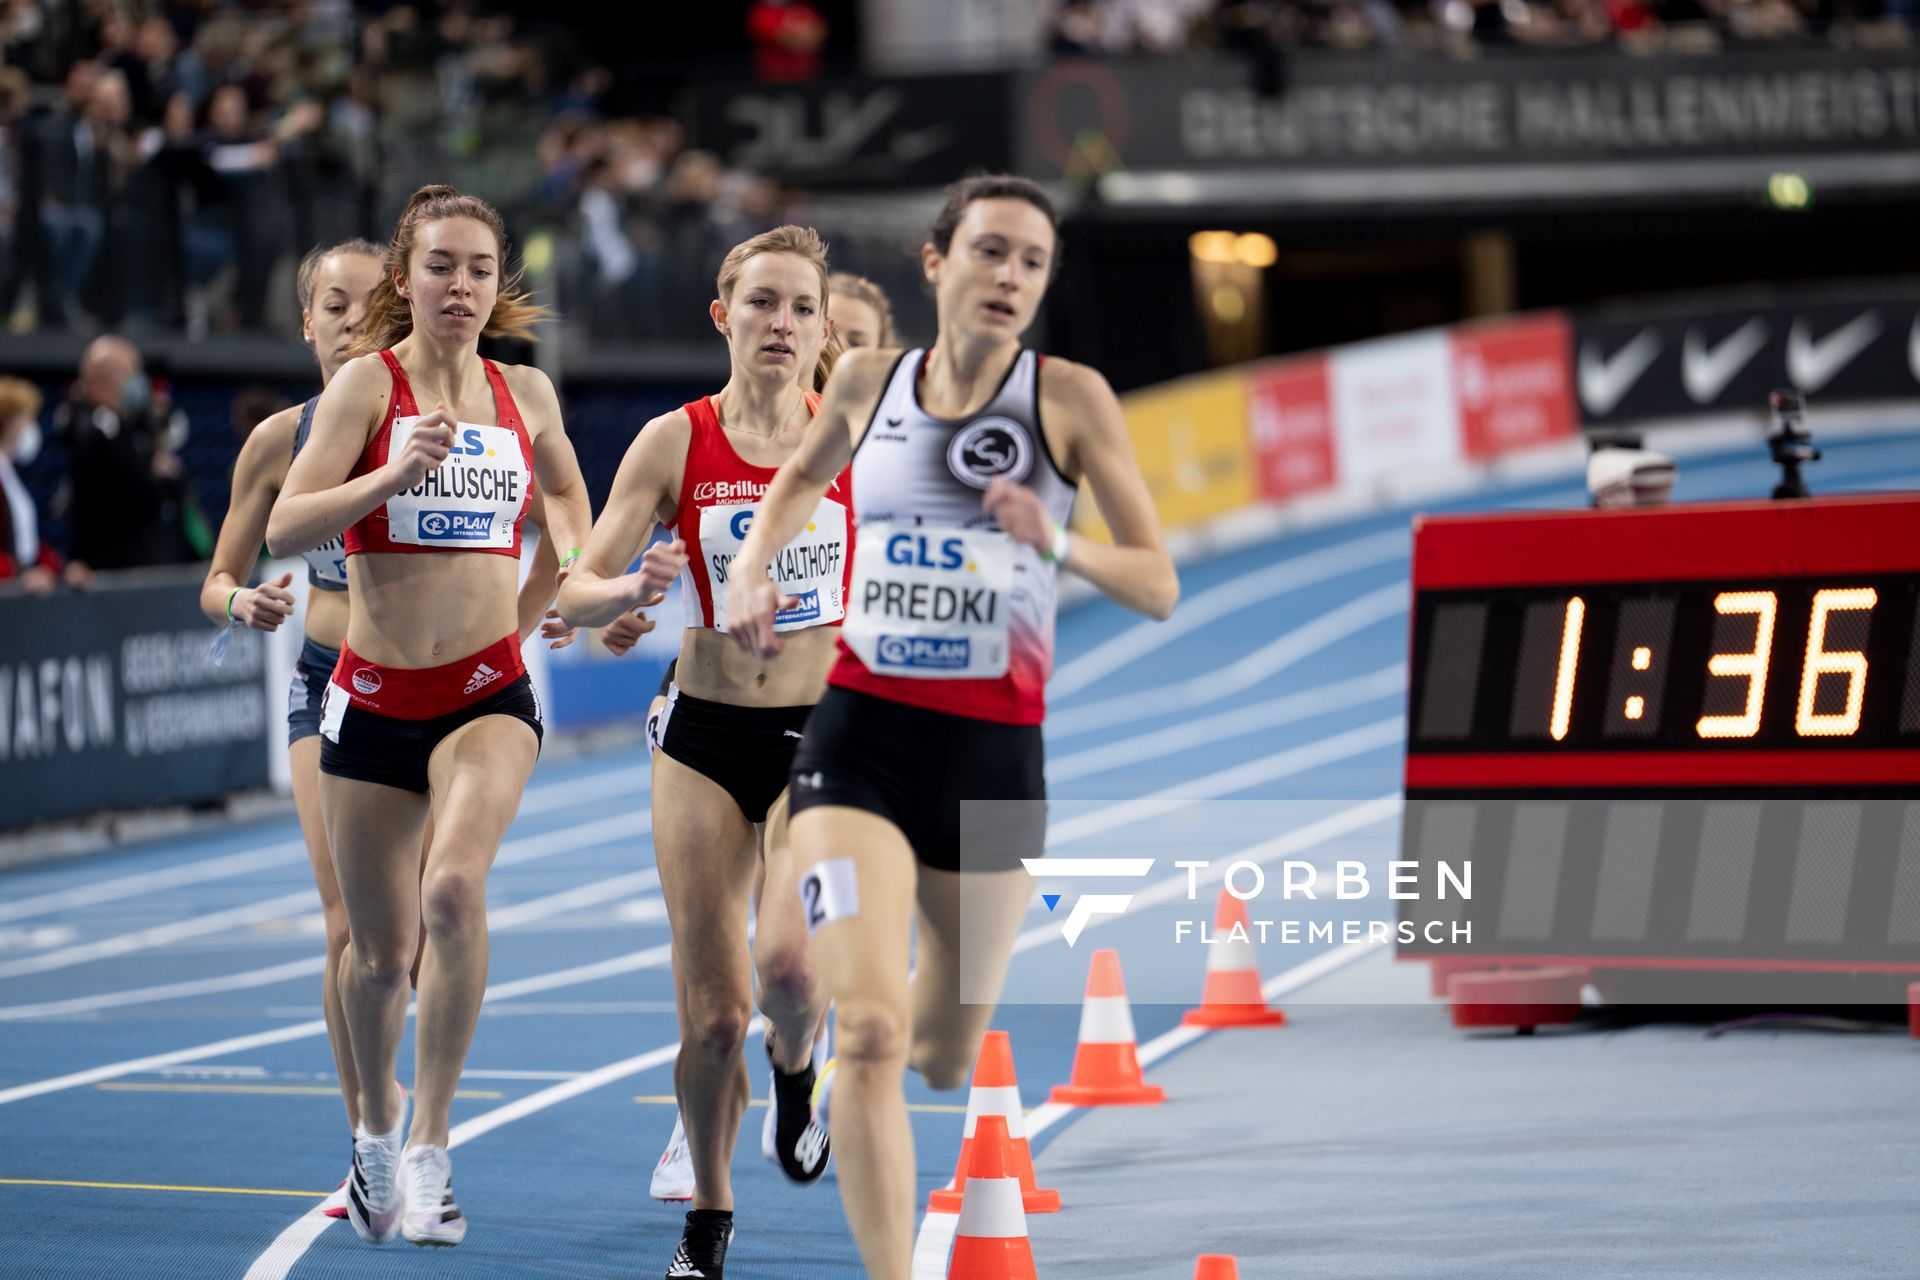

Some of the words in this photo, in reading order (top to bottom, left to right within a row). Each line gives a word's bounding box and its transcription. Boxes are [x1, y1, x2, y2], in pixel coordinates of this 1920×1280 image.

[397, 457, 518, 503] HLÜSCHE
[453, 516, 490, 529] PLAN
[502, 519, 511, 534] 154
[776, 542, 840, 583] KALTHOFF
[831, 588, 839, 607] 320
[864, 580, 997, 624] PREDKI
[913, 640, 966, 658] PLAN
[1550, 588, 1878, 740] 1:36
[463, 670, 503, 694] adidas
[804, 874, 825, 929] 2
